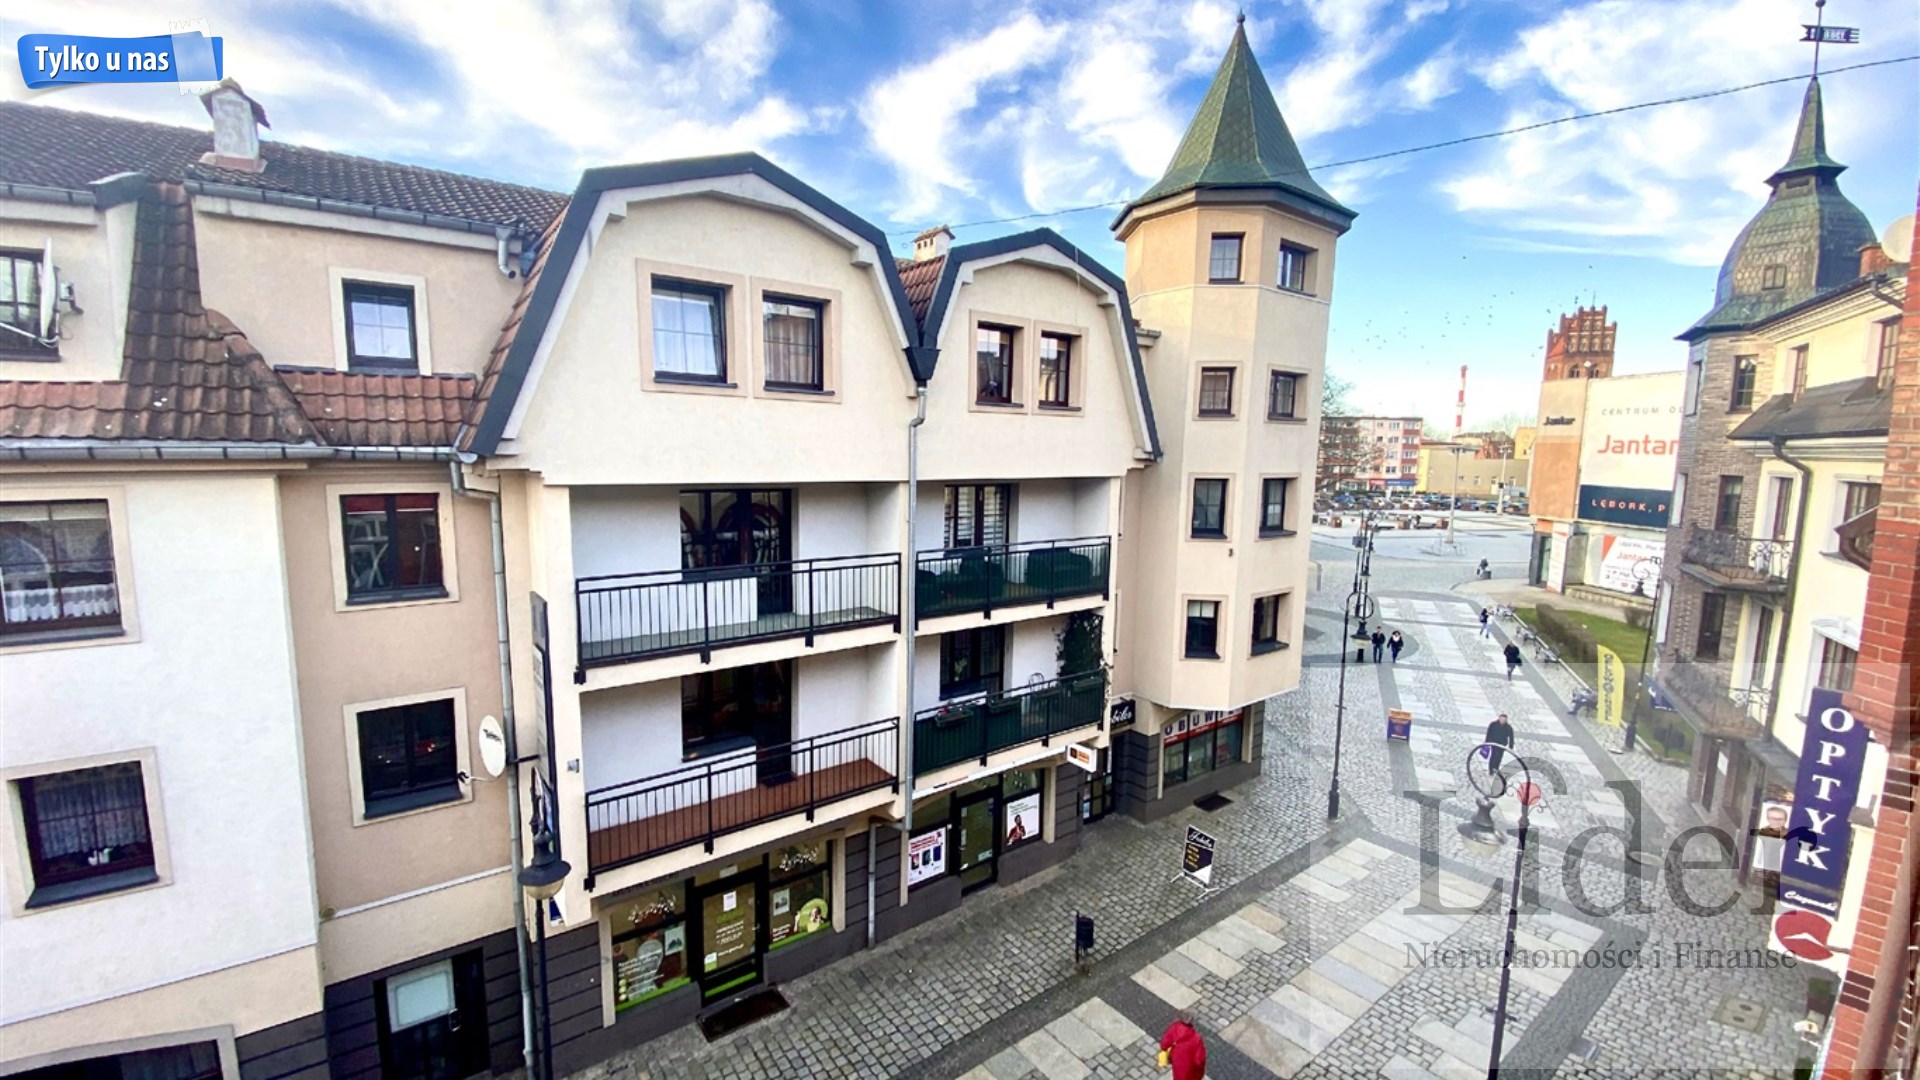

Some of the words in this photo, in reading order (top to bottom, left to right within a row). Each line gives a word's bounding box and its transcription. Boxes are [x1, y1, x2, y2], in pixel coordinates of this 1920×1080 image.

[1601, 407, 1660, 416] CENTRUM
[1542, 415, 1576, 426] Jantar
[1597, 434, 1681, 456] Jantar
[1794, 707, 1855, 871] OPTYK
